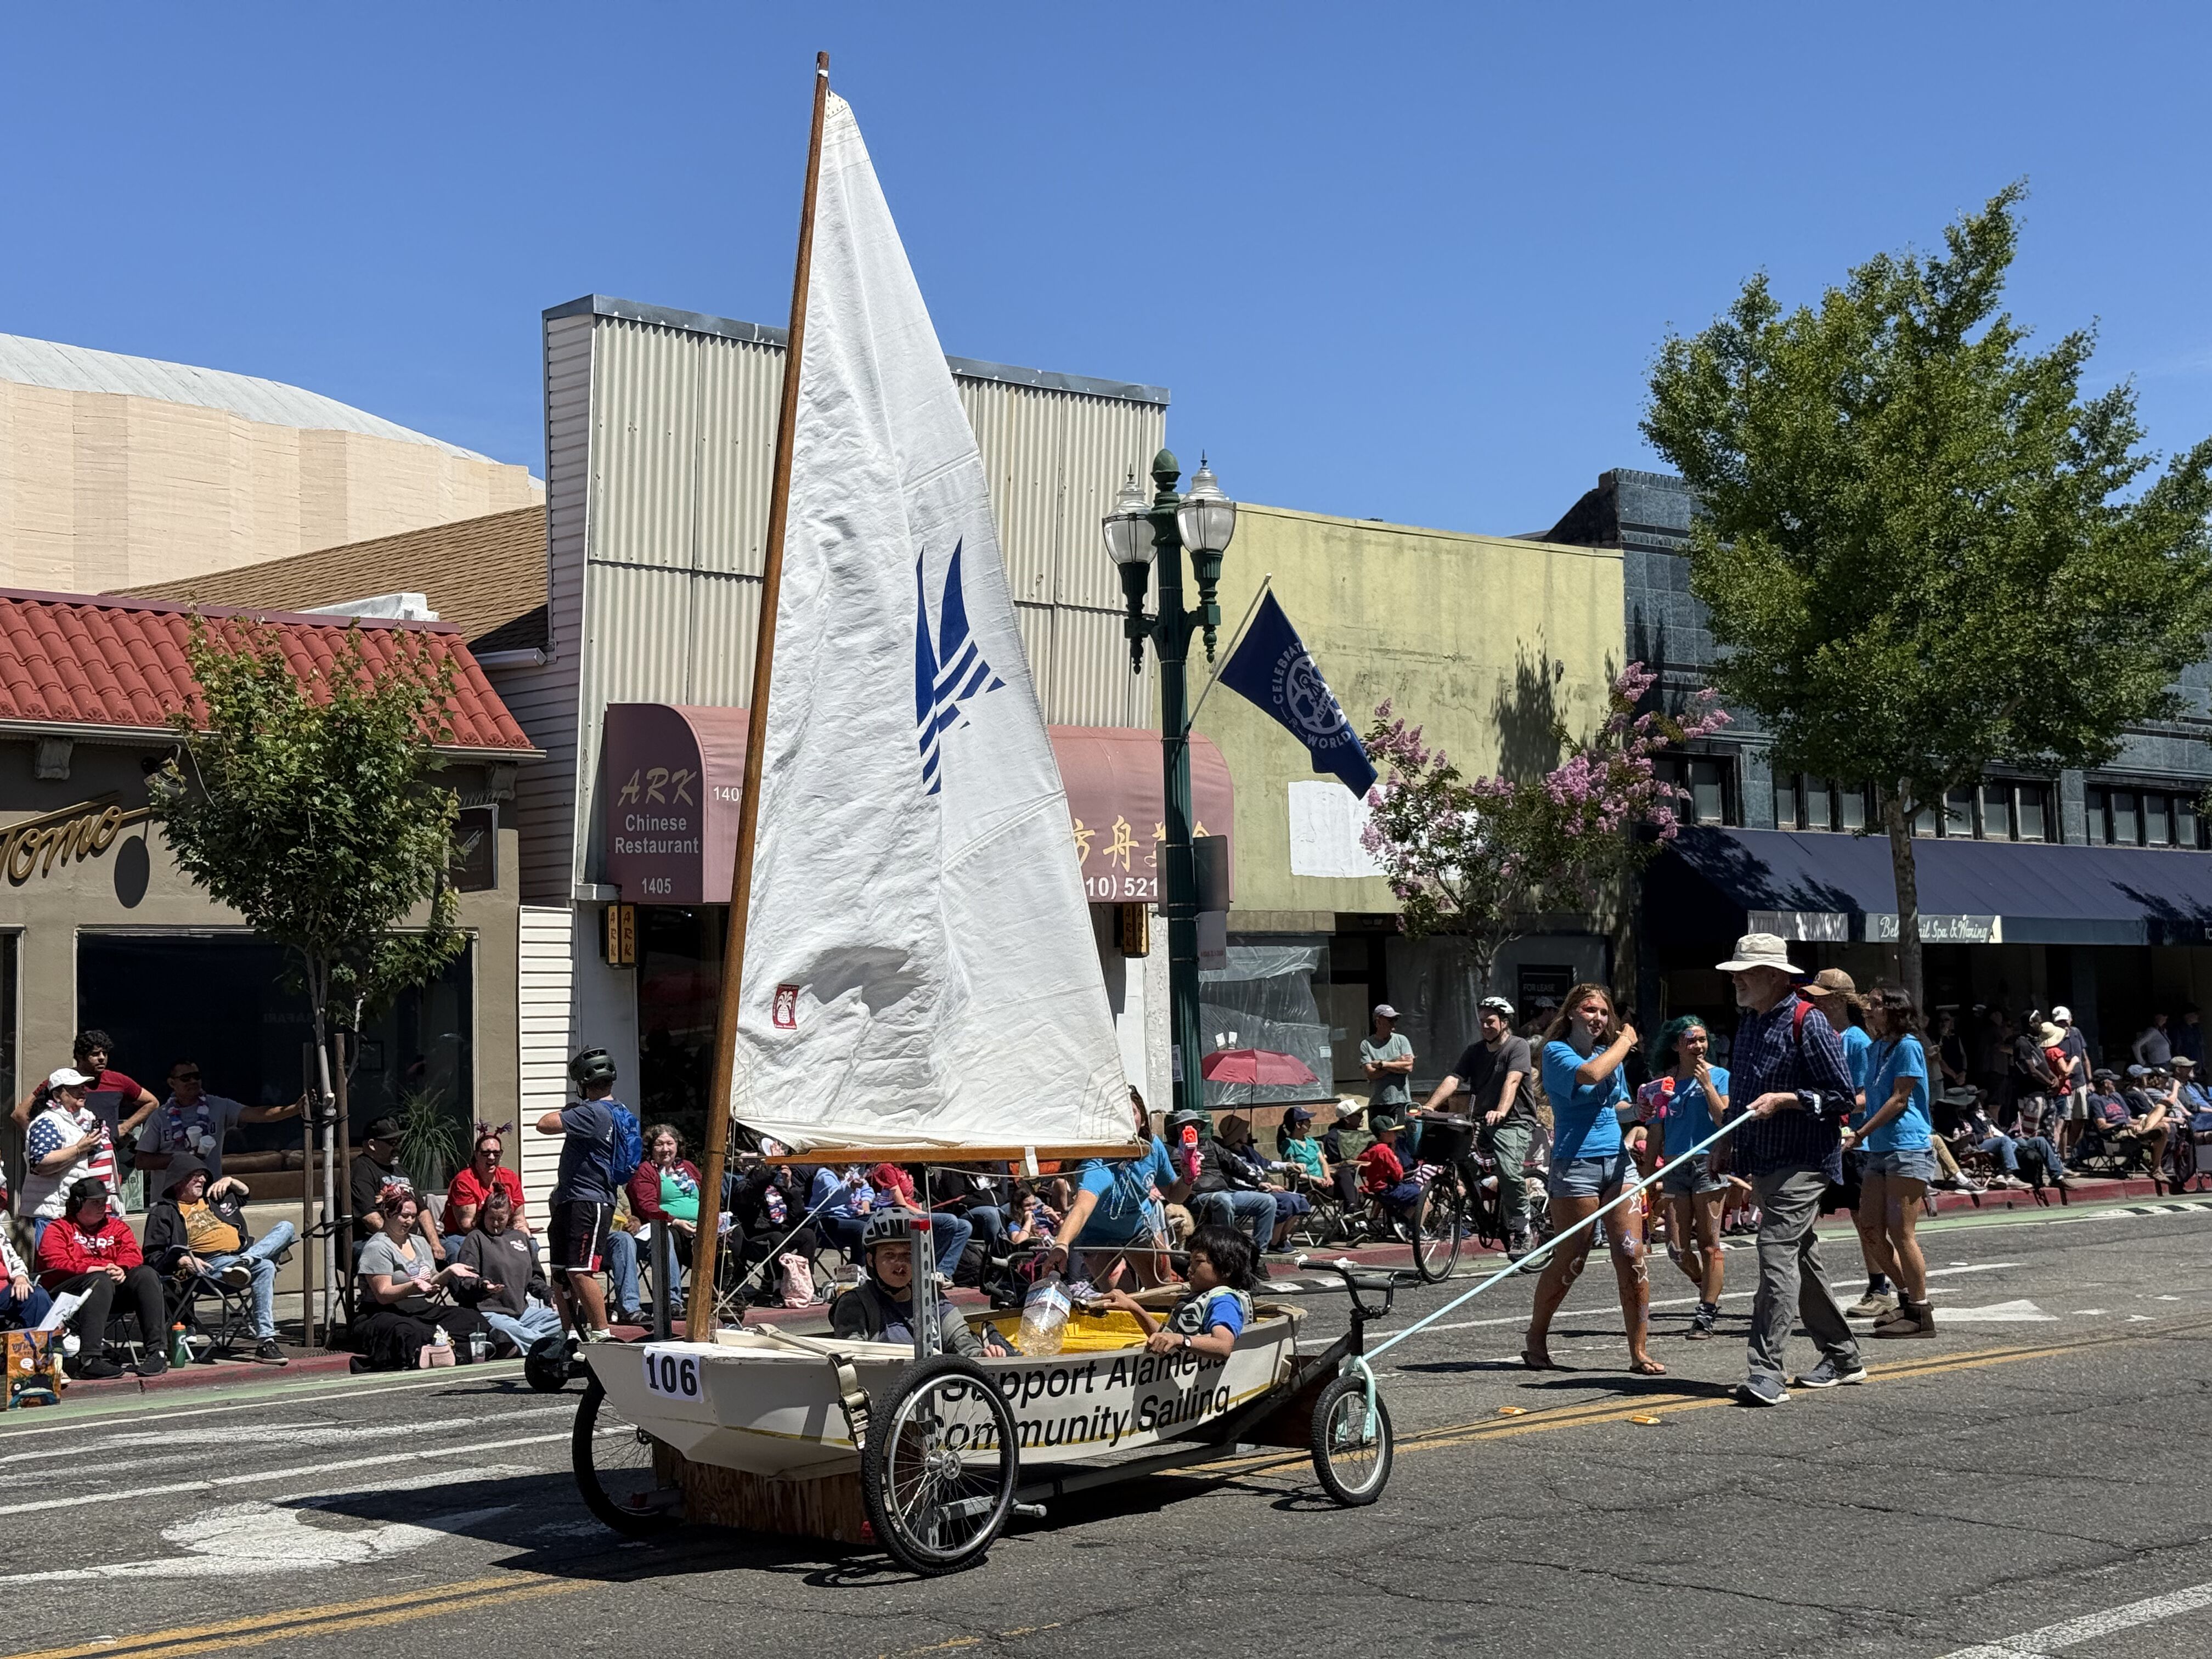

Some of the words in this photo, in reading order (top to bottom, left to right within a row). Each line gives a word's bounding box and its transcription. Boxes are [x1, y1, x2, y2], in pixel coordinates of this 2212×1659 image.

[1272, 642, 1305, 705] CELEBRAT
[1307, 731, 1351, 749] WORLD
[617, 768, 697, 808] ARK
[713, 786, 742, 802] 140
[625, 814, 687, 832] Chinese
[615, 837, 699, 854] Restaurant
[641, 878, 672, 894] 1405
[623, 911, 633, 957] ARK
[1932, 919, 1948, 943] Spa
[1950, 918, 1958, 938] &
[1958, 919, 1988, 944] Waxing
[1537, 984, 1555, 992] LEASE
[646, 1352, 697, 1396] 106
[1138, 1384, 1231, 1432] Sailing
